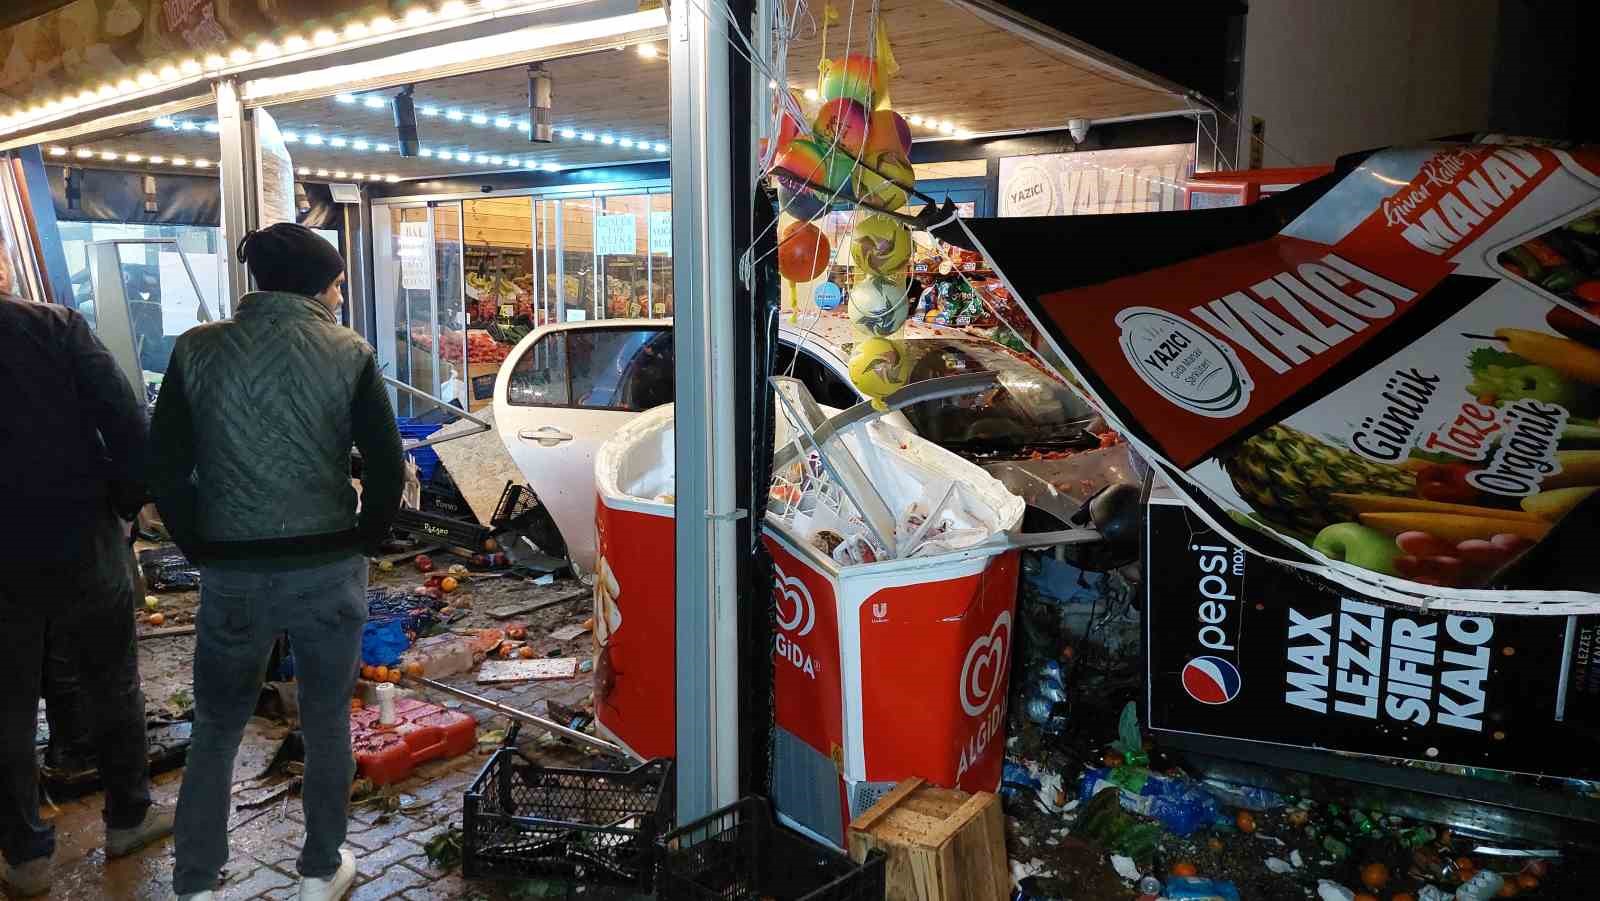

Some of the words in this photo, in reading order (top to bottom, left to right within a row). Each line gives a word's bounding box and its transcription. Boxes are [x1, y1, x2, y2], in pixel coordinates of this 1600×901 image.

[1010, 183, 1044, 203] YAZICI
[1144, 330, 1191, 371] YAZICI
[1190, 254, 1418, 374] YAZICI
[1352, 368, 1440, 460] Günlük
[1426, 402, 1502, 457] Taze
[1474, 400, 1562, 493] Organik
[1192, 543, 1236, 652] pepsi
[1232, 546, 1246, 577] max
[1285, 607, 1333, 714] MAX
[1384, 618, 1438, 727] SIFIR
